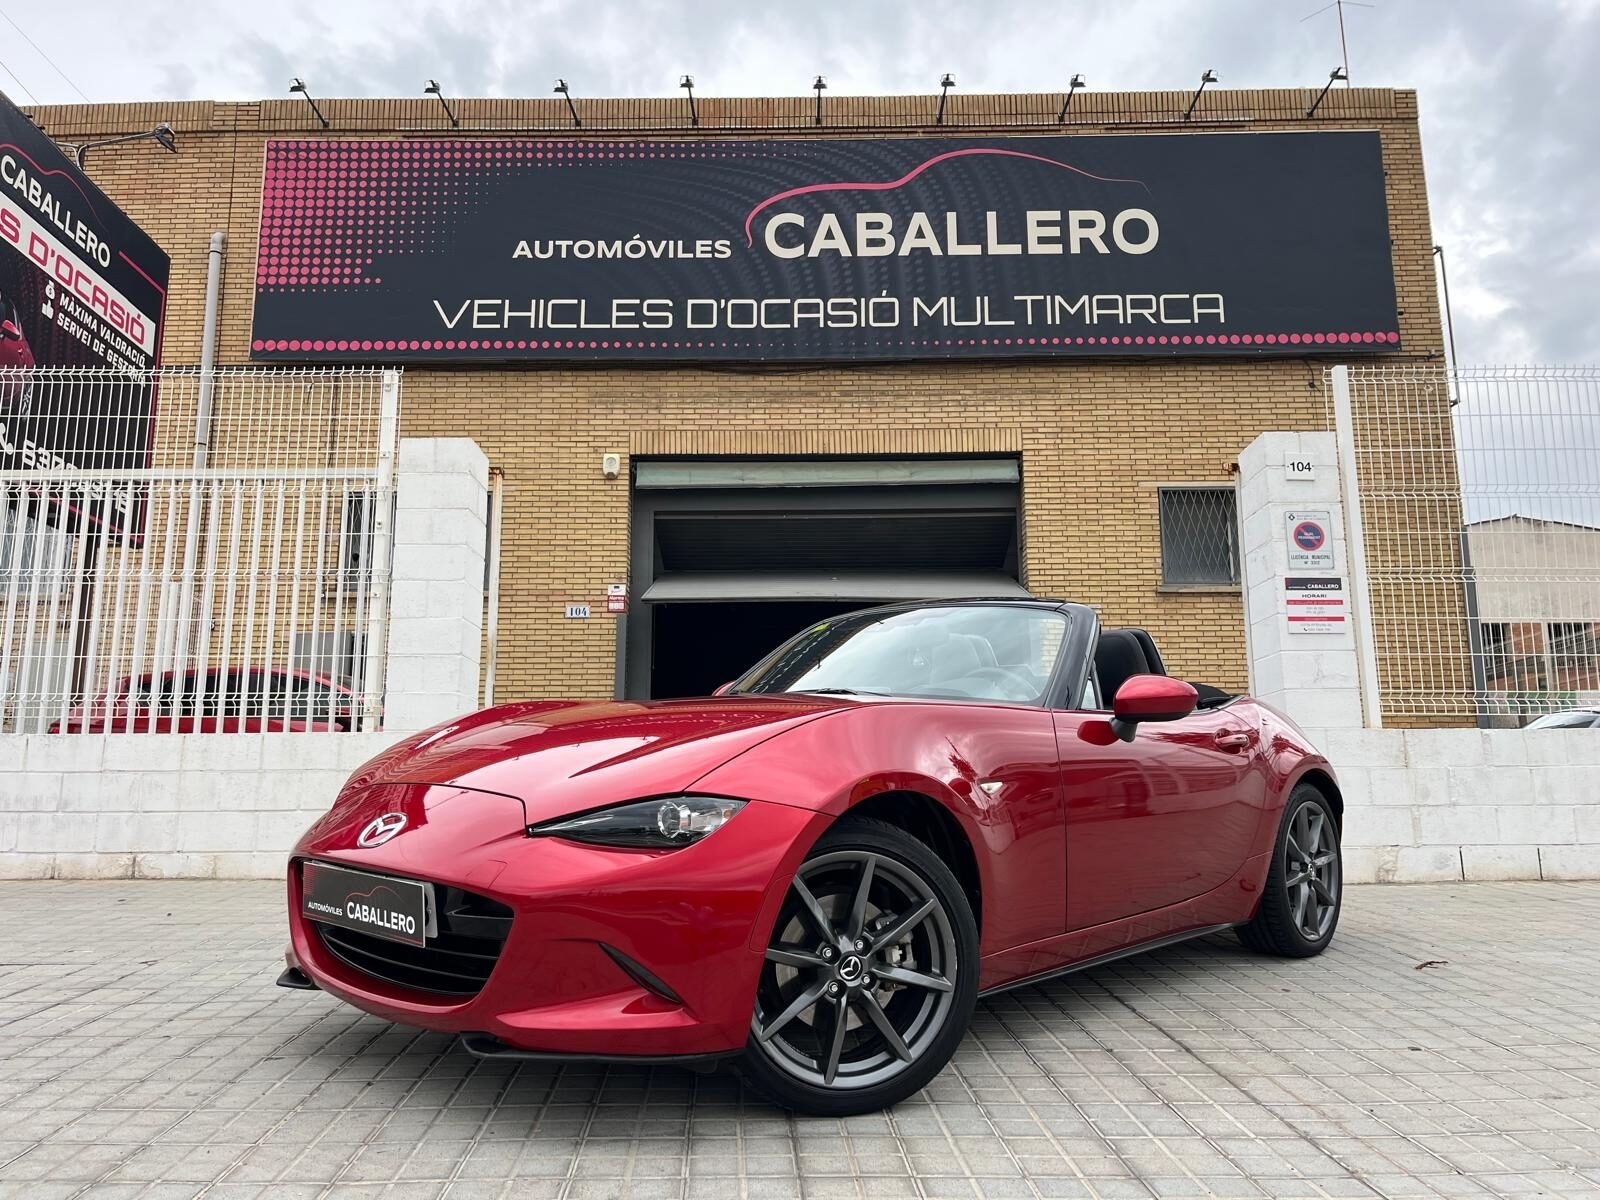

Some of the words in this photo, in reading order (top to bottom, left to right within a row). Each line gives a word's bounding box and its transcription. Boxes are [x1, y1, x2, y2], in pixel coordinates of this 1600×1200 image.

[1, 155, 110, 267] CABALLERO
[512, 233, 732, 259] AUTOMÓVILES
[764, 208, 1160, 259] CABALLERO
[29, 231, 145, 345] D'OCASIÓ
[433, 299, 673, 329] VEHICLES
[686, 290, 899, 329] D'OCASIÓ
[913, 294, 1225, 327] MULTIMARCA
[57, 313, 91, 346] SERVEI
[92, 339, 106, 356] DE
[60, 293, 98, 332] MÀXIMA
[101, 324, 145, 367] VALORACIÓ
[1289, 462, 1312, 472] 104
[570, 607, 587, 616] 104
[308, 901, 343, 916] AUTOMÓVILES
[346, 902, 416, 934] CABALLERO
